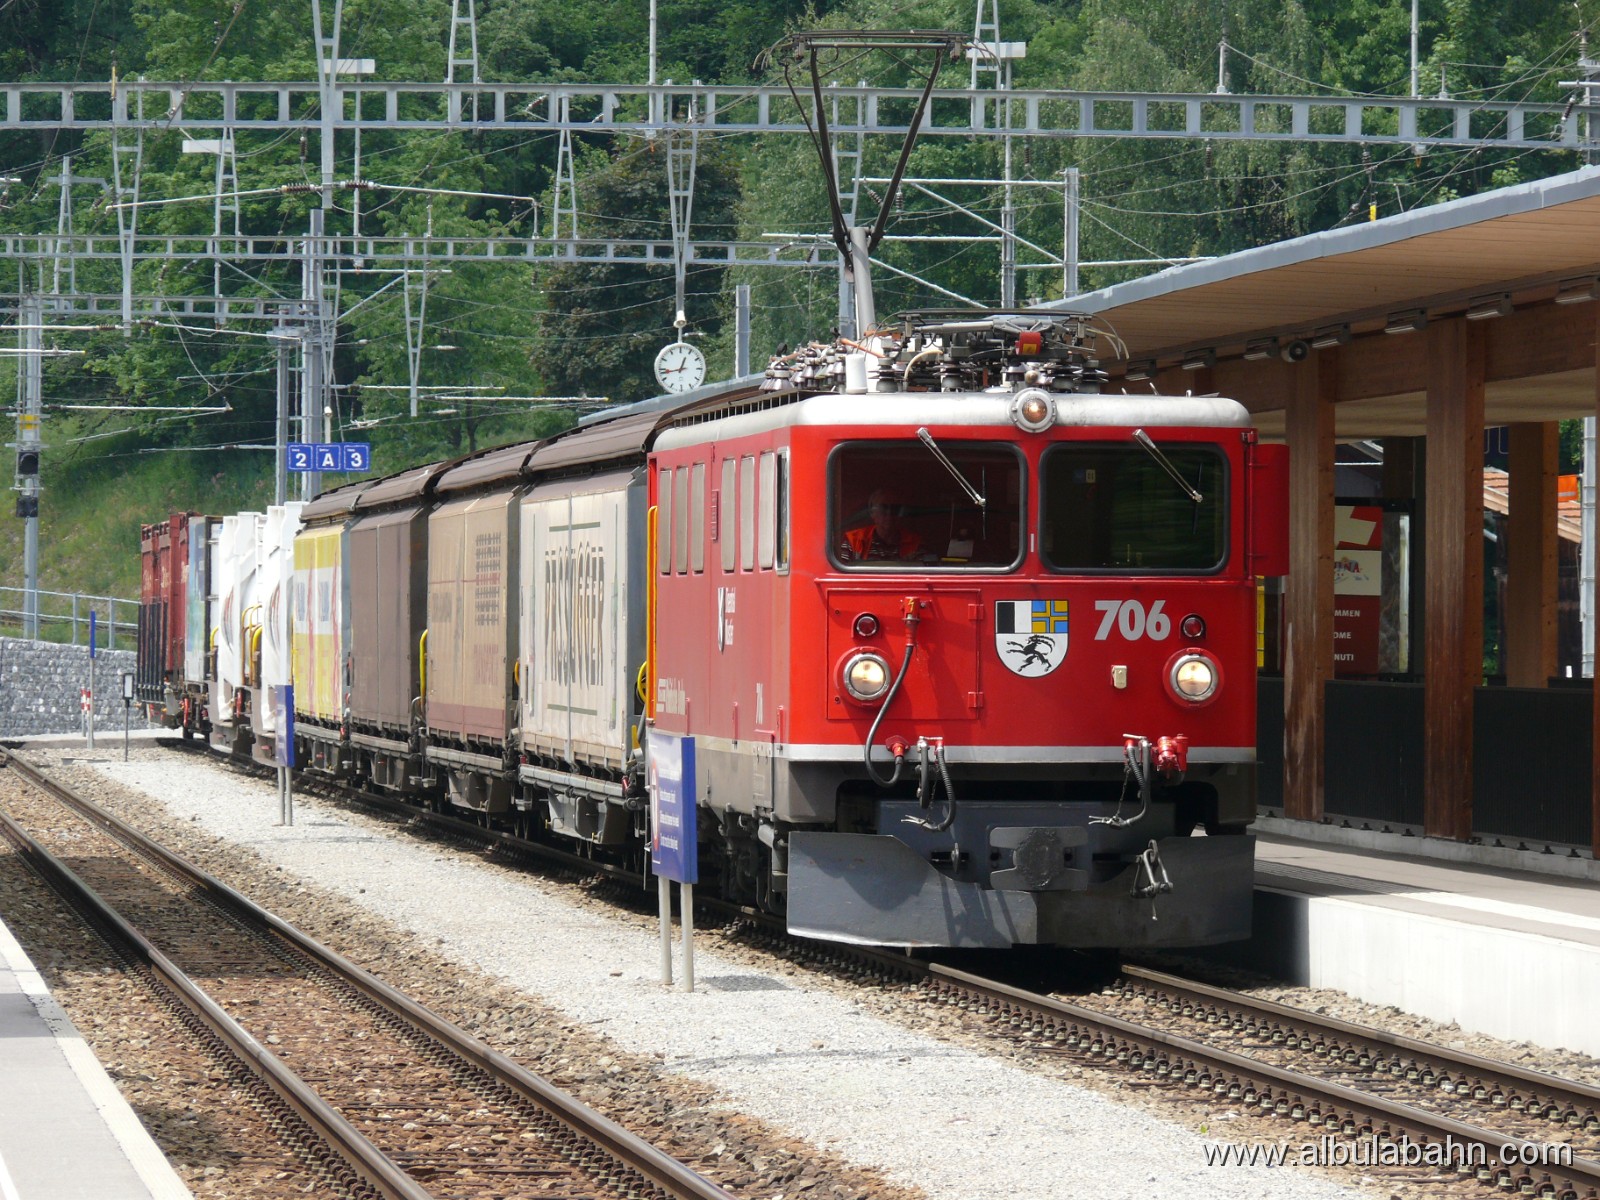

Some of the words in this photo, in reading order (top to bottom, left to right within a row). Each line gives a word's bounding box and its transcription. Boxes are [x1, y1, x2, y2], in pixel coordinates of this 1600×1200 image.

[295, 452, 307, 467] 2
[321, 452, 335, 467] A
[350, 452, 363, 468] 3
[1094, 599, 1171, 641] 706
